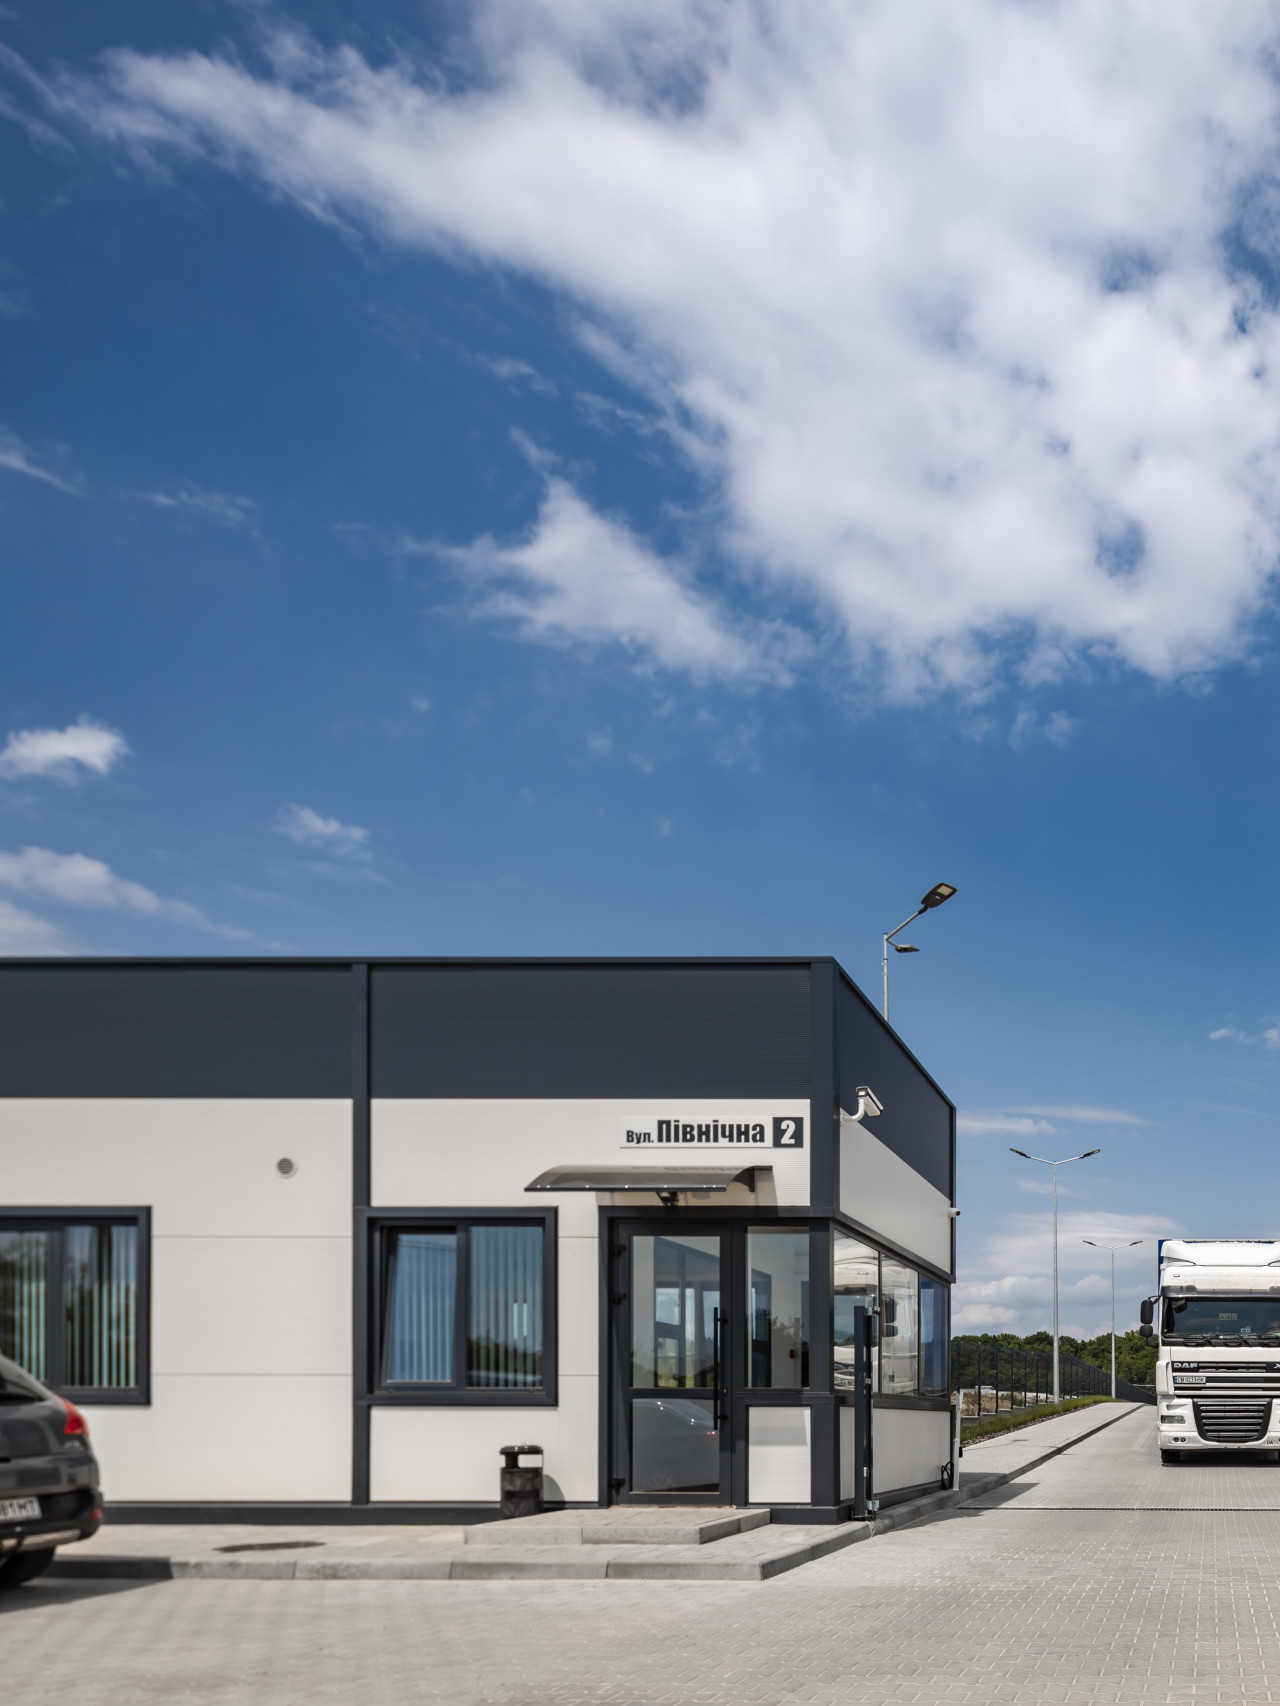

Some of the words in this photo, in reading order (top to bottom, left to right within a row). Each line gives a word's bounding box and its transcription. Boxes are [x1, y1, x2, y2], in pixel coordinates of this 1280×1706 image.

[626, 1130, 655, 1145] Вул.
[657, 1119, 765, 1143] Північна
[780, 1119, 796, 1144] 2
